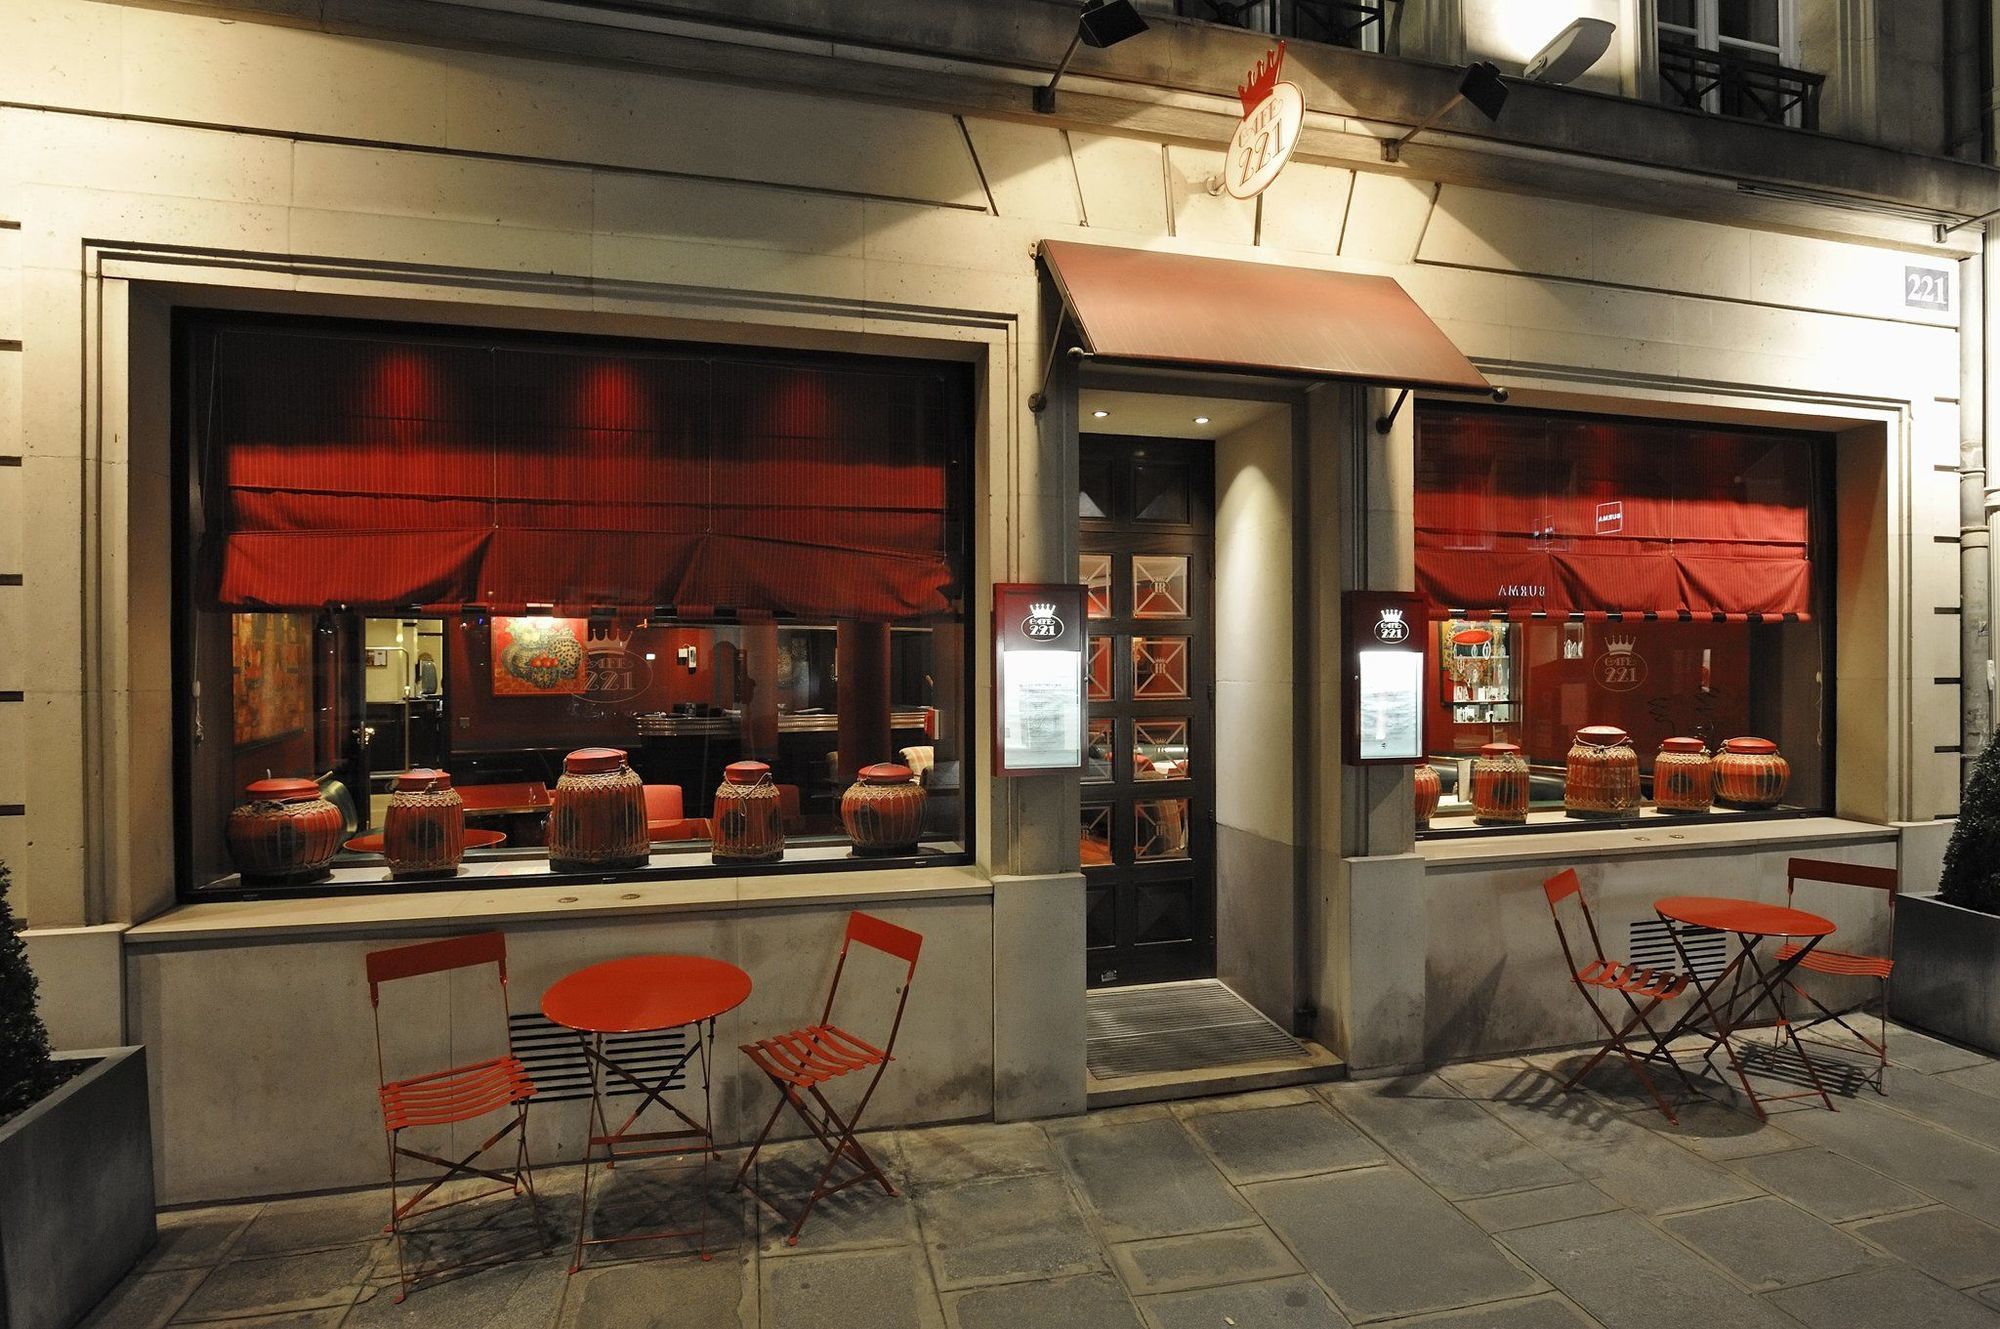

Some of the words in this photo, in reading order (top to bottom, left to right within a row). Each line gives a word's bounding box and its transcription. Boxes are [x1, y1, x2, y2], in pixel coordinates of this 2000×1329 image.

[1238, 117, 1287, 187] 221
[1907, 273, 1948, 304] 221
[1029, 624, 1056, 636] 221
[1380, 628, 1402, 639] 221
[579, 670, 635, 691] 221
[1604, 666, 1638, 682] 221
